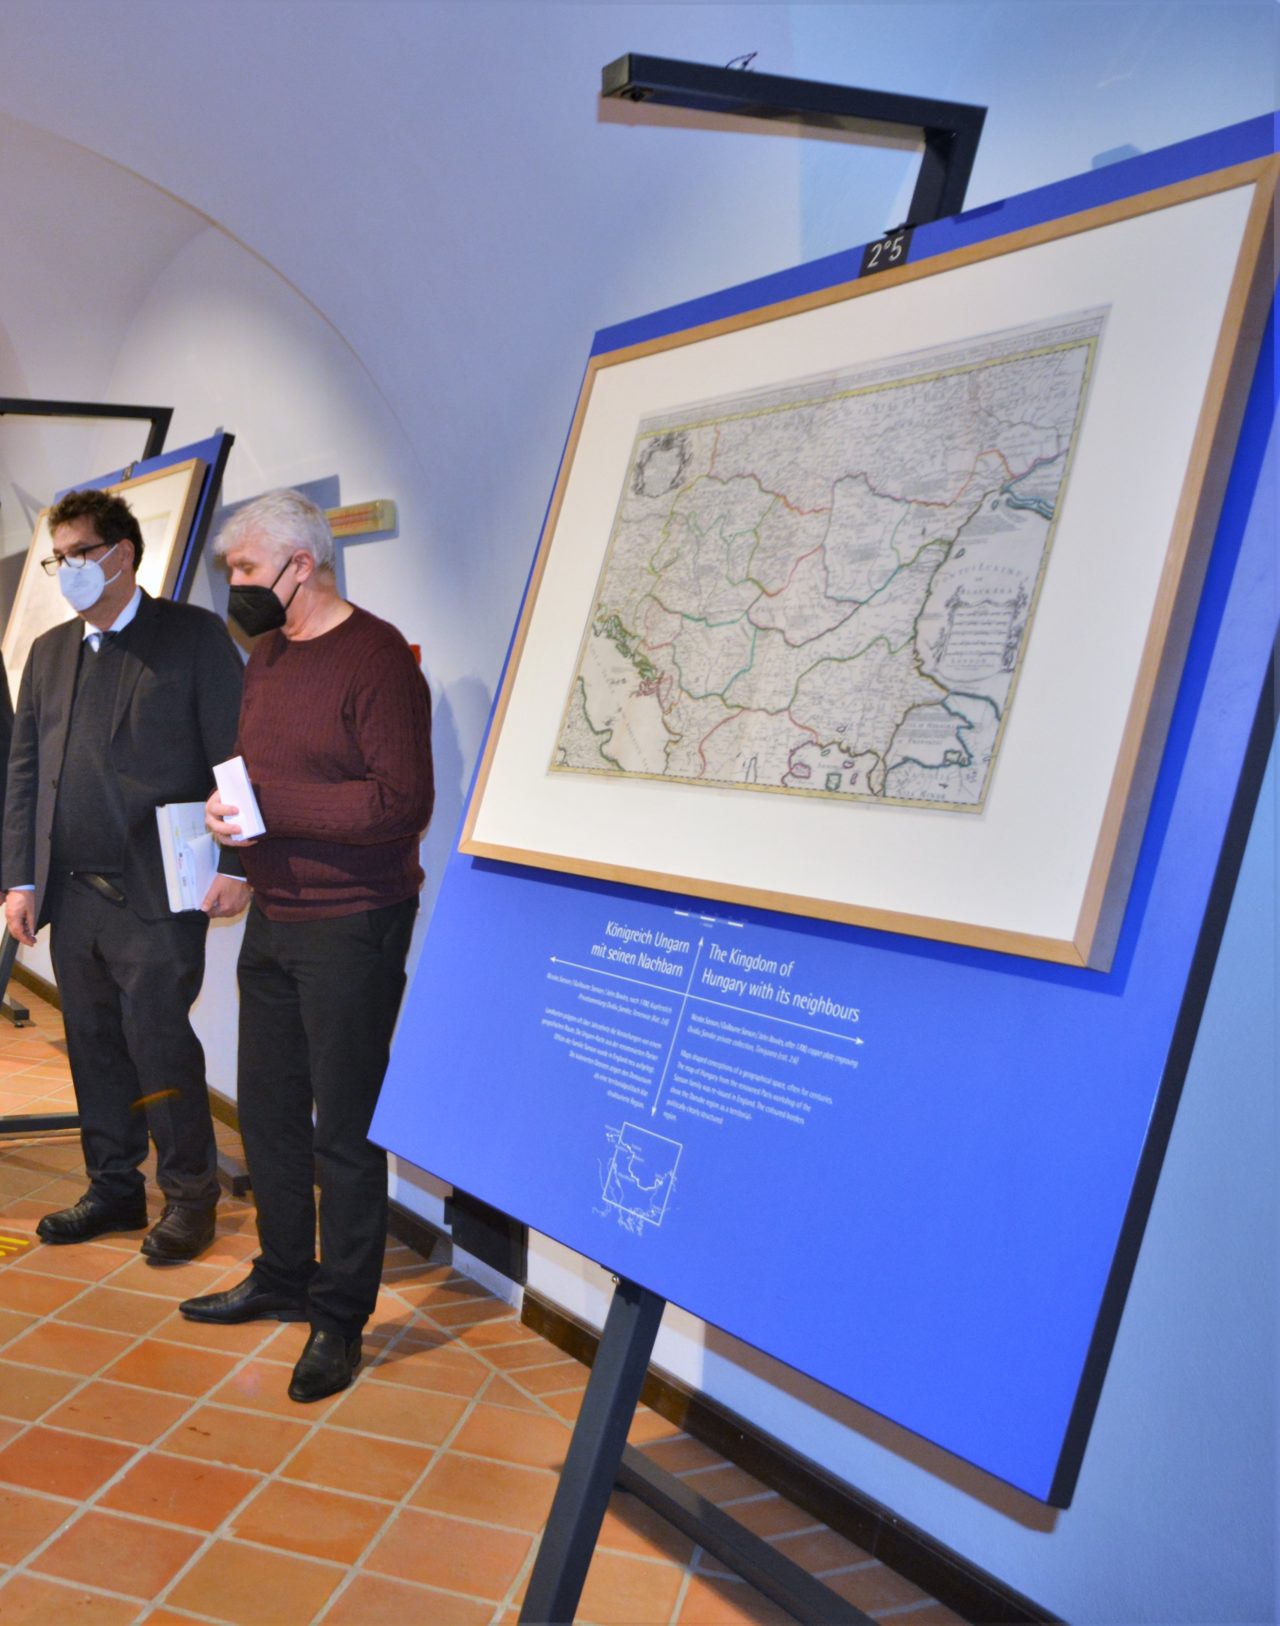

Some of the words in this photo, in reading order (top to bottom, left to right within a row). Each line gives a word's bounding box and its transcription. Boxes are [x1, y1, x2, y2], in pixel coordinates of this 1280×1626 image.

[605, 921, 653, 944] Königreich
[653, 932, 690, 954] Ungarn
[590, 943, 606, 958] mit
[607, 947, 636, 966] seinen
[637, 952, 683, 976] Nachbarn
[709, 943, 727, 962] The
[729, 948, 777, 972] Kingdom
[779, 961, 795, 977] of
[701, 968, 747, 996] Hungary
[748, 981, 774, 1000] with
[775, 986, 791, 1005] its
[792, 993, 860, 1022] neighbours
